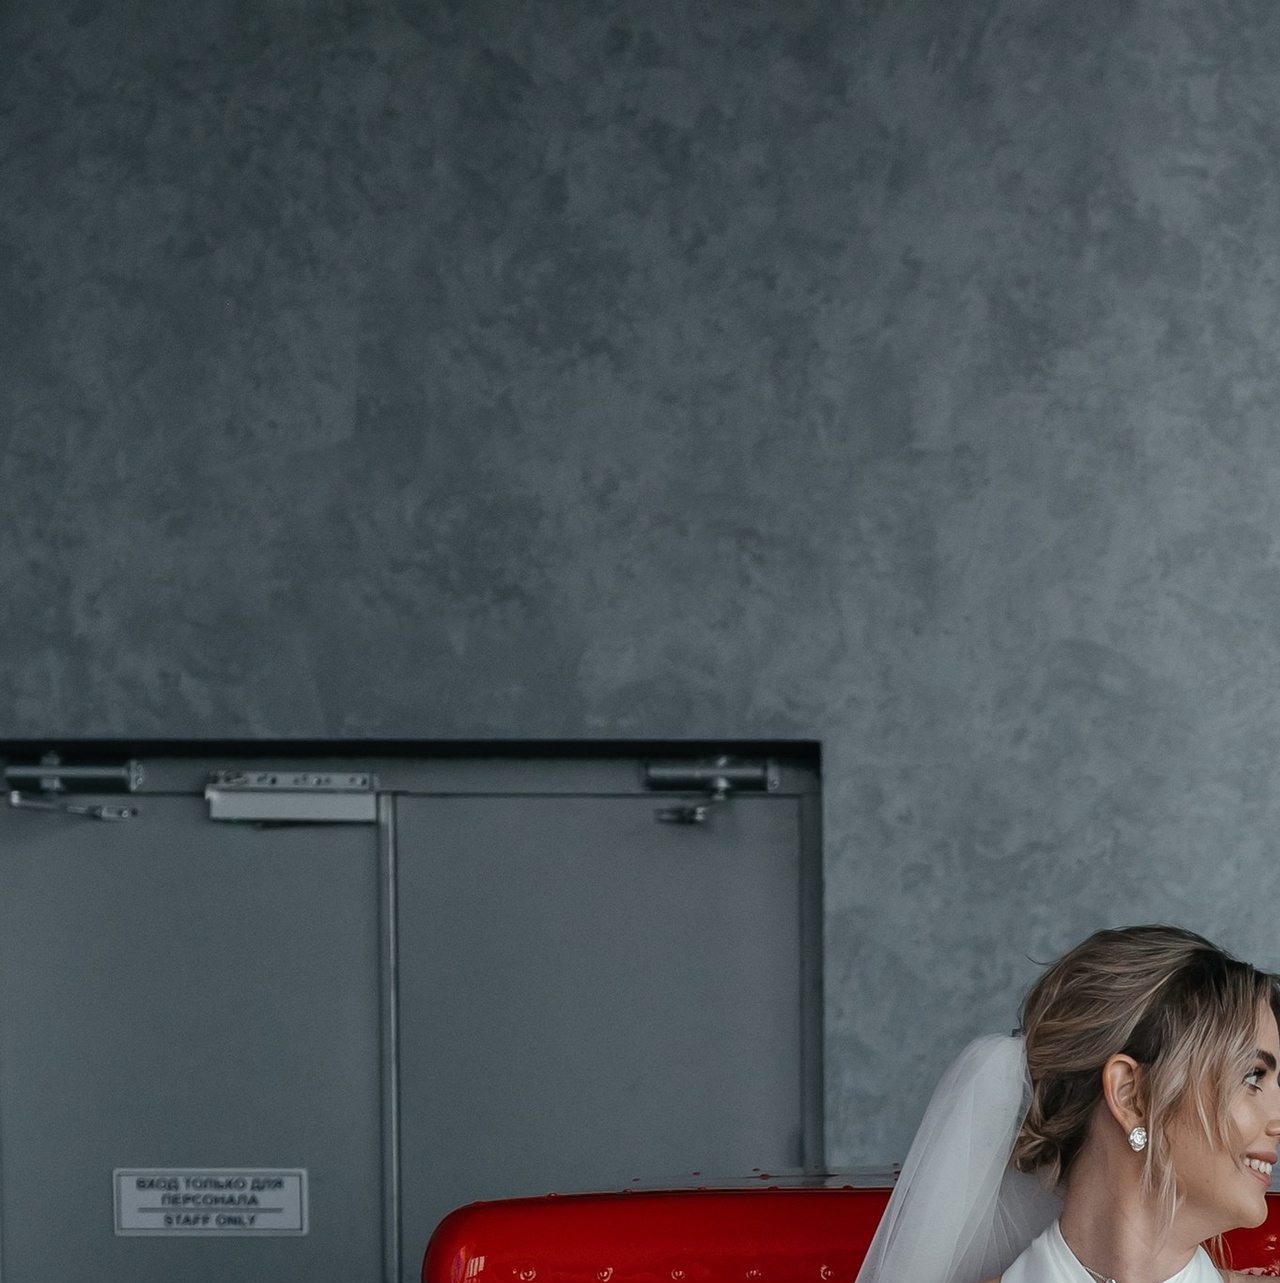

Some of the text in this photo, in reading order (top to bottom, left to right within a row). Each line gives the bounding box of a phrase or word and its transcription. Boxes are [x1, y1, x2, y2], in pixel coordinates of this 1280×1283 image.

[136, 1178, 284, 1191] ВХОД ТОЛЬКО ДЛЯ
[161, 1194, 260, 1206] ПЕРСОНАЛА
[163, 1214, 257, 1226] STAFF ONLY
